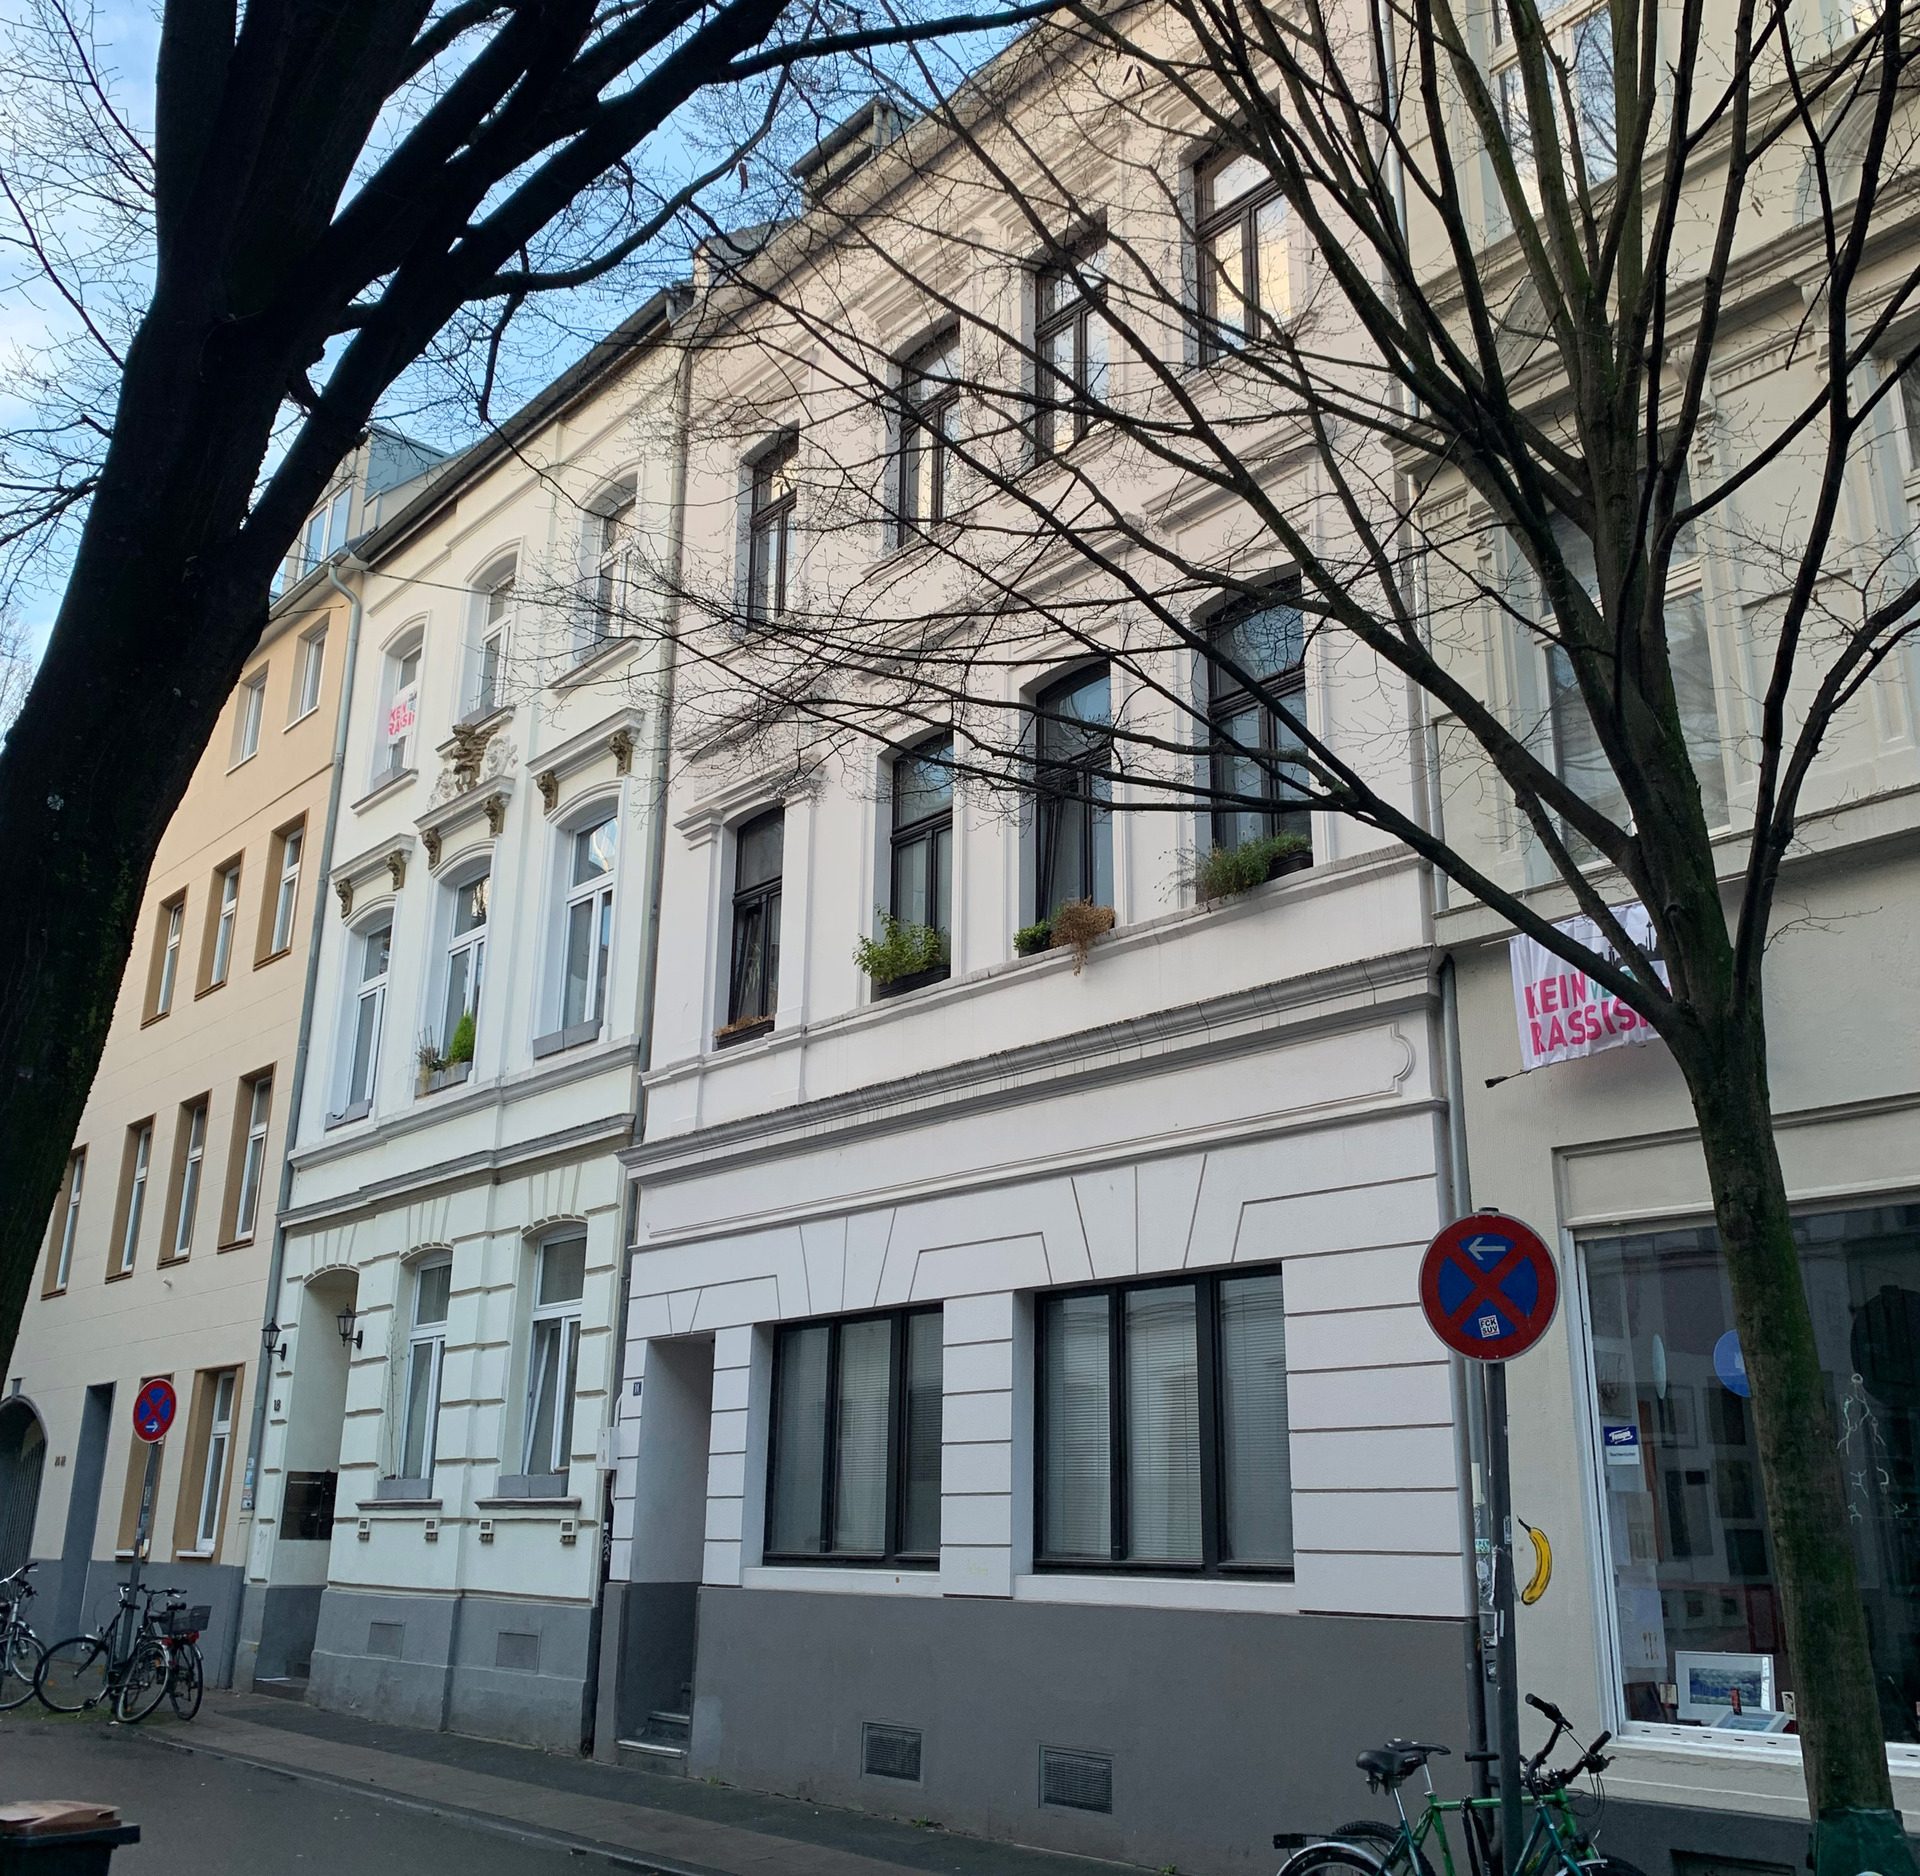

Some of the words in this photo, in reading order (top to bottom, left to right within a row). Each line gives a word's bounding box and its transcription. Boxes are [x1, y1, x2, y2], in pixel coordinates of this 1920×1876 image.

[1524, 971, 1586, 1019] KEIN
[1530, 997, 1648, 1056] RASSIS
[1480, 1318, 1497, 1327] FCK
